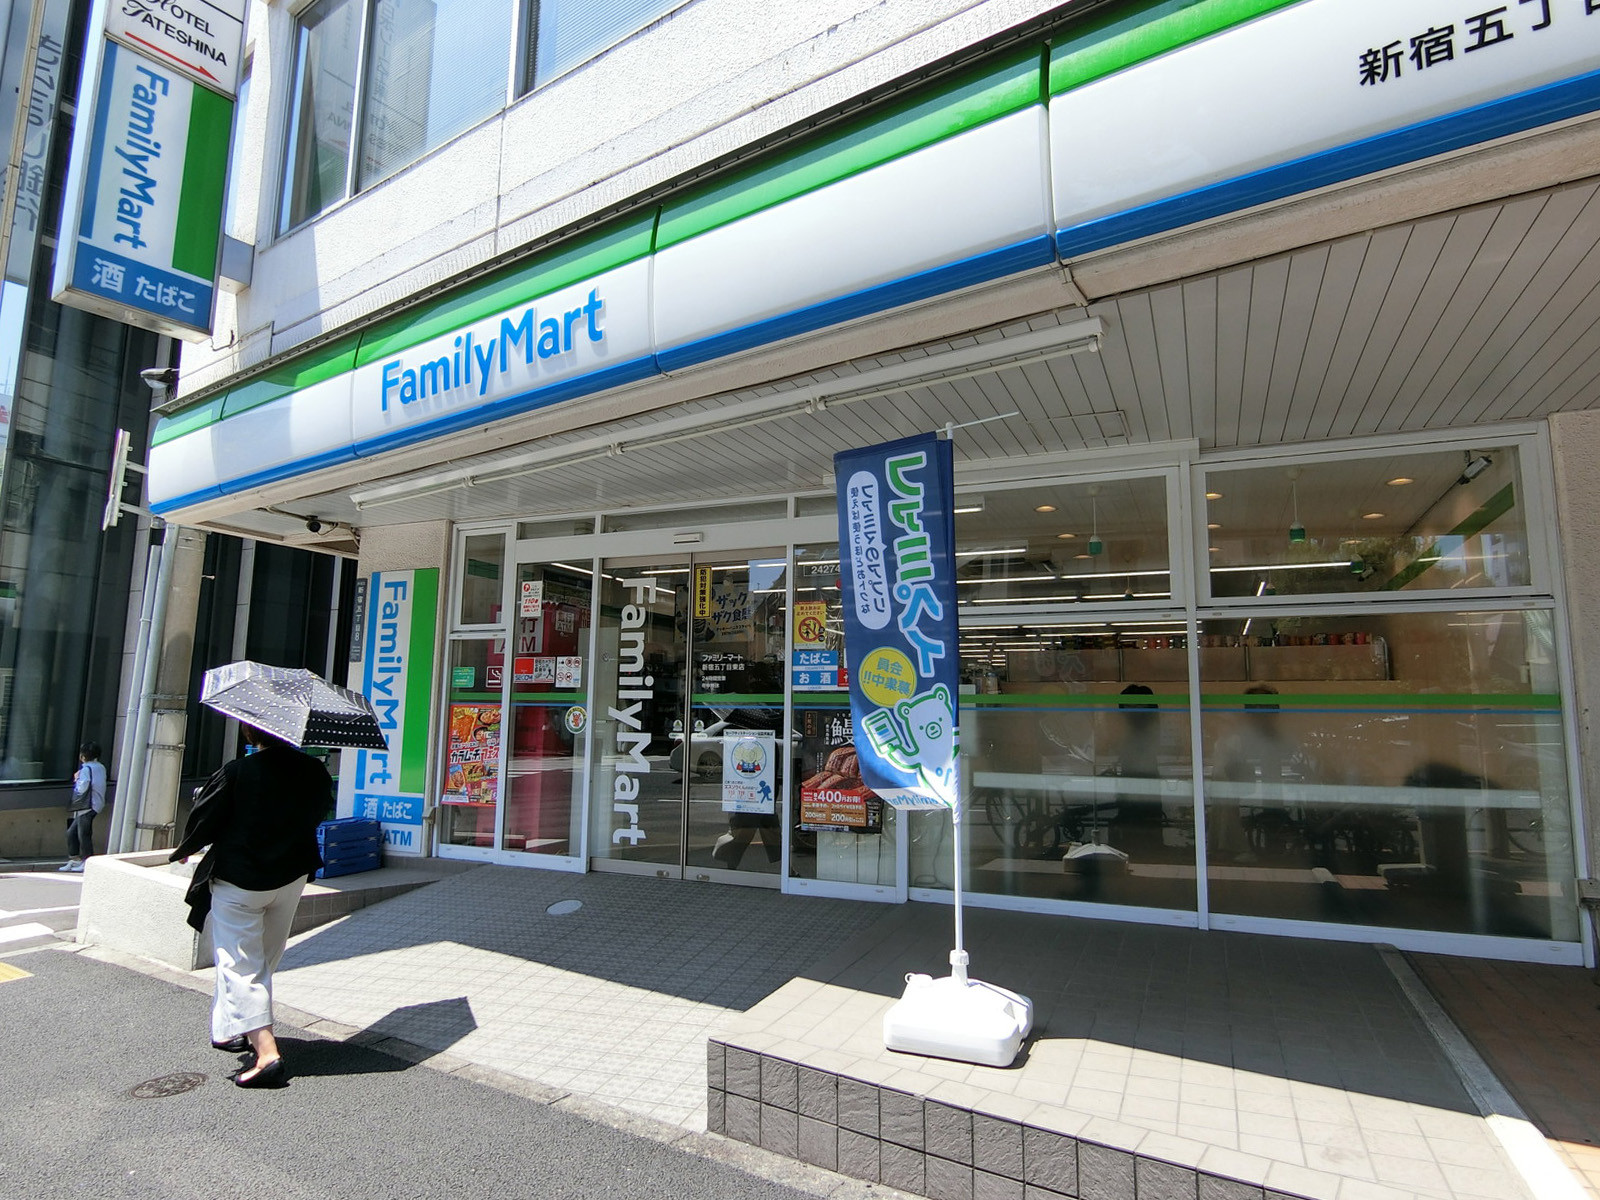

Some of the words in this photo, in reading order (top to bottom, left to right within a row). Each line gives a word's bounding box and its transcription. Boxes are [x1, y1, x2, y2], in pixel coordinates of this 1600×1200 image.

[122, 0, 227, 66] TATESHINA
[1358, 0, 1600, 86] 新宿五丁
[114, 64, 169, 249] FamilyMart
[91, 257, 126, 294] 酒
[134, 275, 196, 314] たばこ
[381, 286, 606, 412] FamilyMart
[369, 579, 407, 785] FamilyMrt
[701, 653, 744, 662] ファミリーマート
[799, 652, 831, 665] たばこ
[607, 576, 656, 847] FamilyMart
[363, 797, 378, 820] 酒
[383, 801, 412, 820] たばこ
[382, 829, 412, 846] ATM
